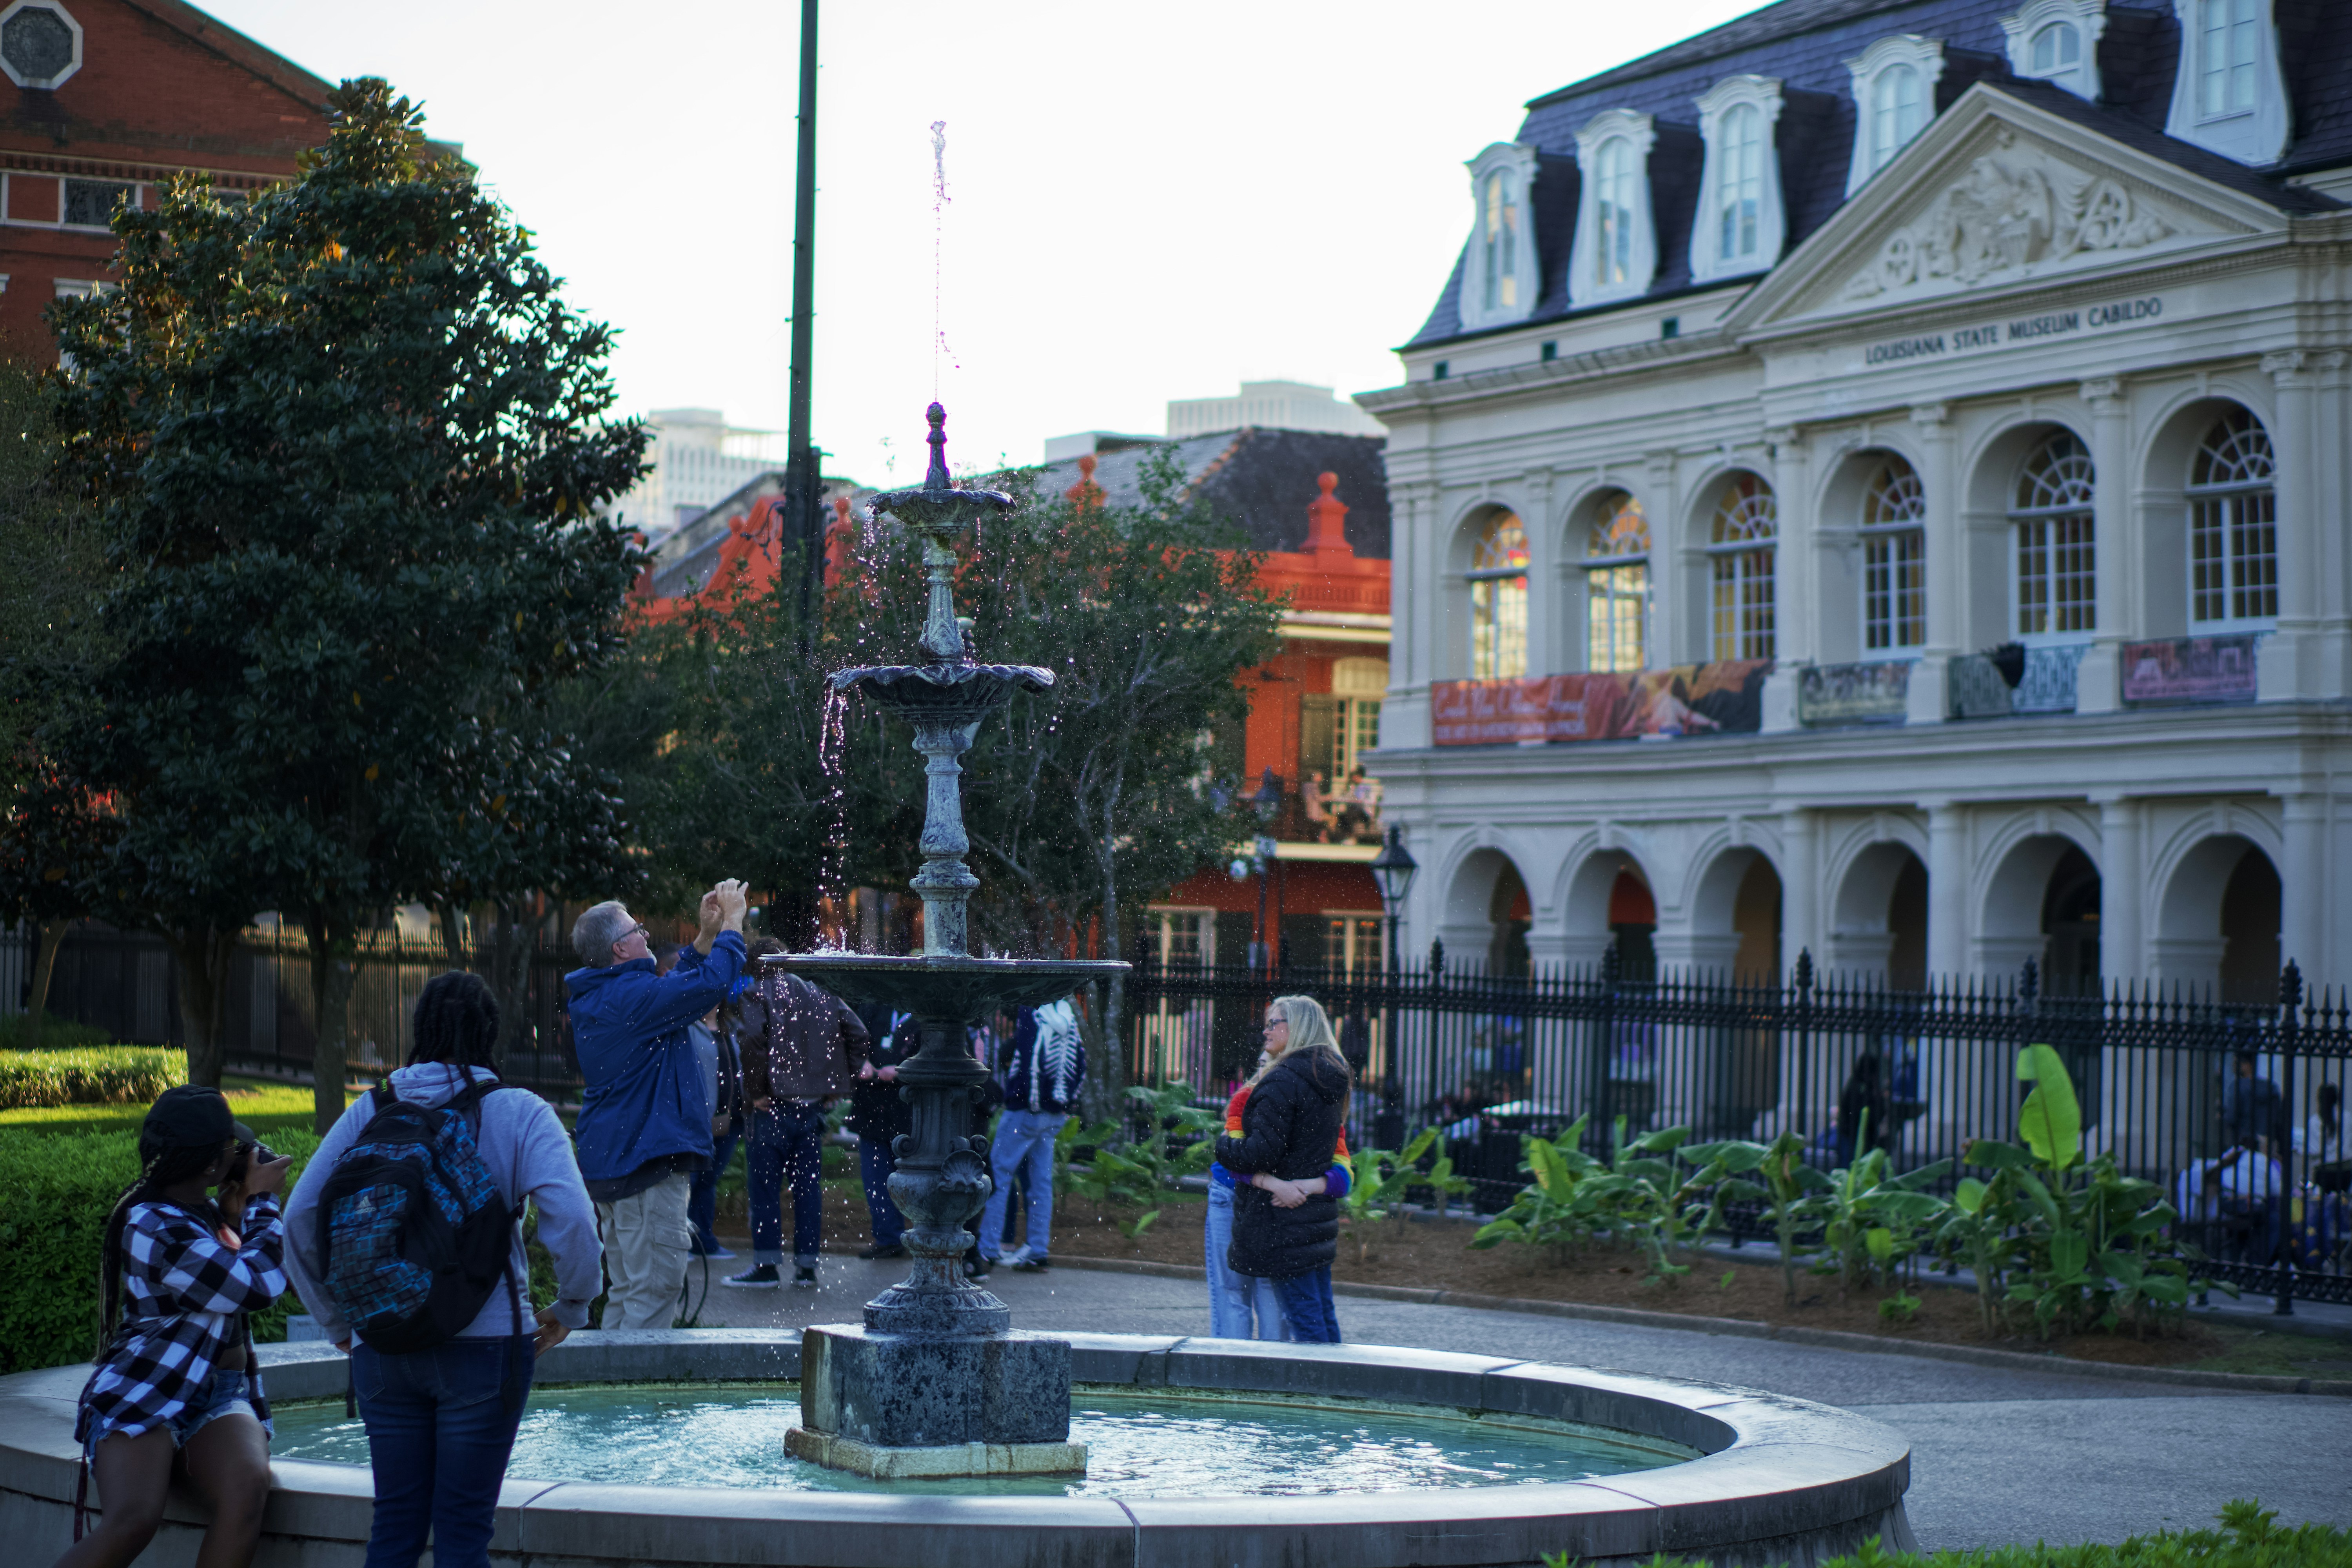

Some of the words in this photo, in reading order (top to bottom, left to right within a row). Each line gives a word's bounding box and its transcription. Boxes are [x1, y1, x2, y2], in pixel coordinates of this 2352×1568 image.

[1866, 335, 1946, 365] LOUISIANA
[1953, 325, 1998, 350] STATE
[2008, 311, 2079, 341] MUSEUM
[2087, 297, 2161, 328] CABILDO
